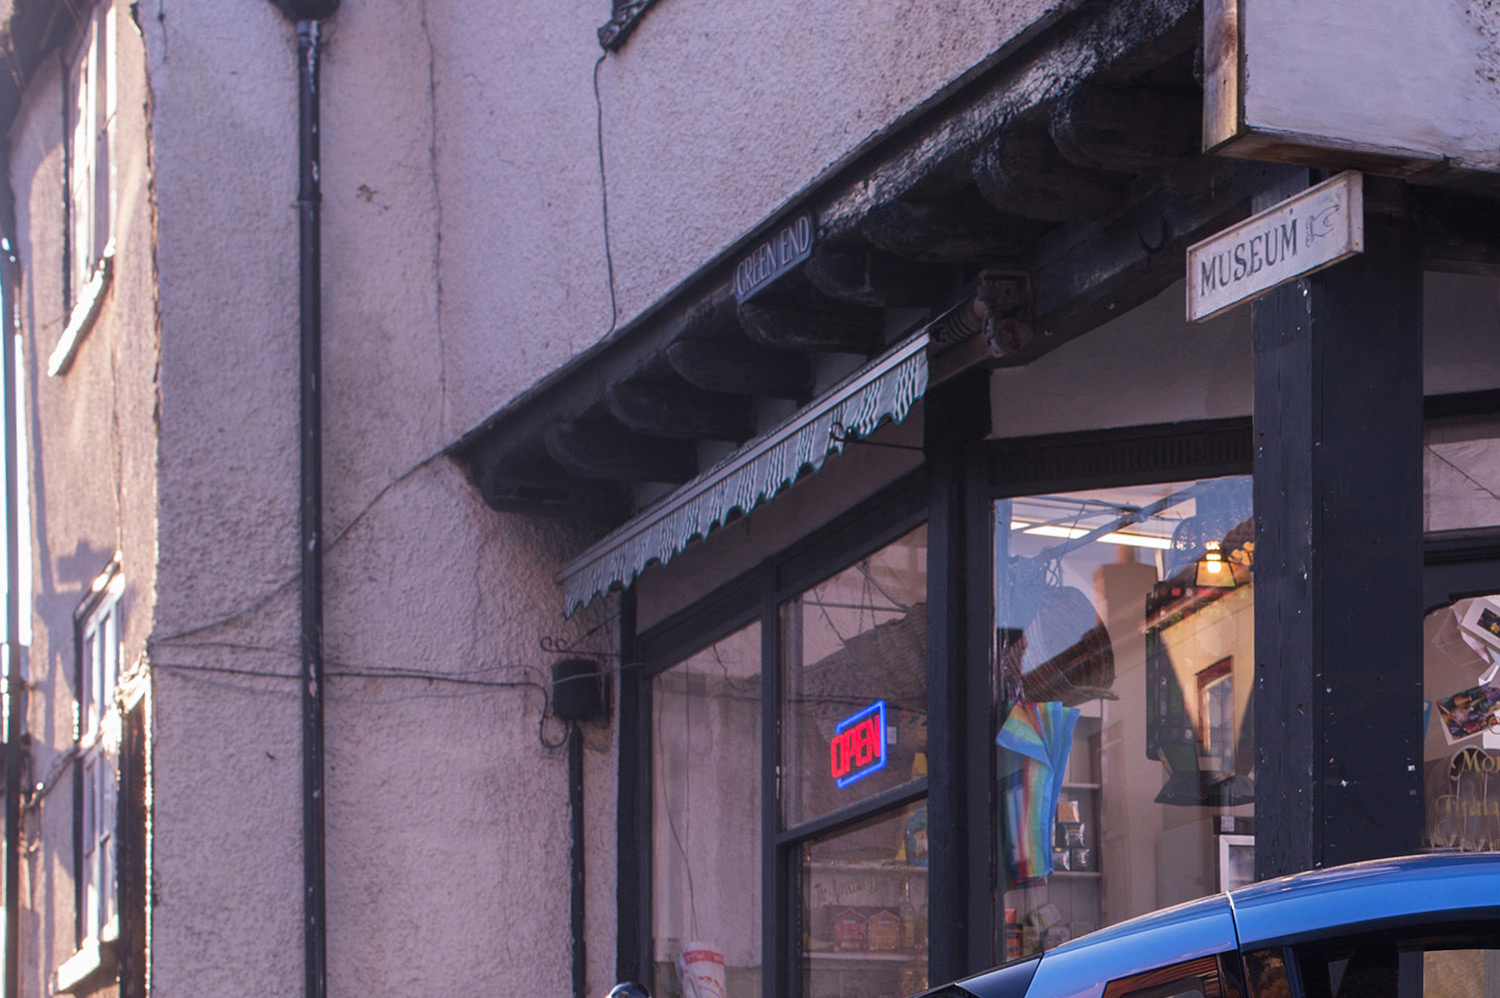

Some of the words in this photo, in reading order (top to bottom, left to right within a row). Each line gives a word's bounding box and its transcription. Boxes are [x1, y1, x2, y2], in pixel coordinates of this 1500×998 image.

[736, 236, 778, 296] GREEN
[780, 215, 810, 266] END
[1200, 217, 1298, 296] MUSEUM
[831, 714, 880, 778] OPEN
